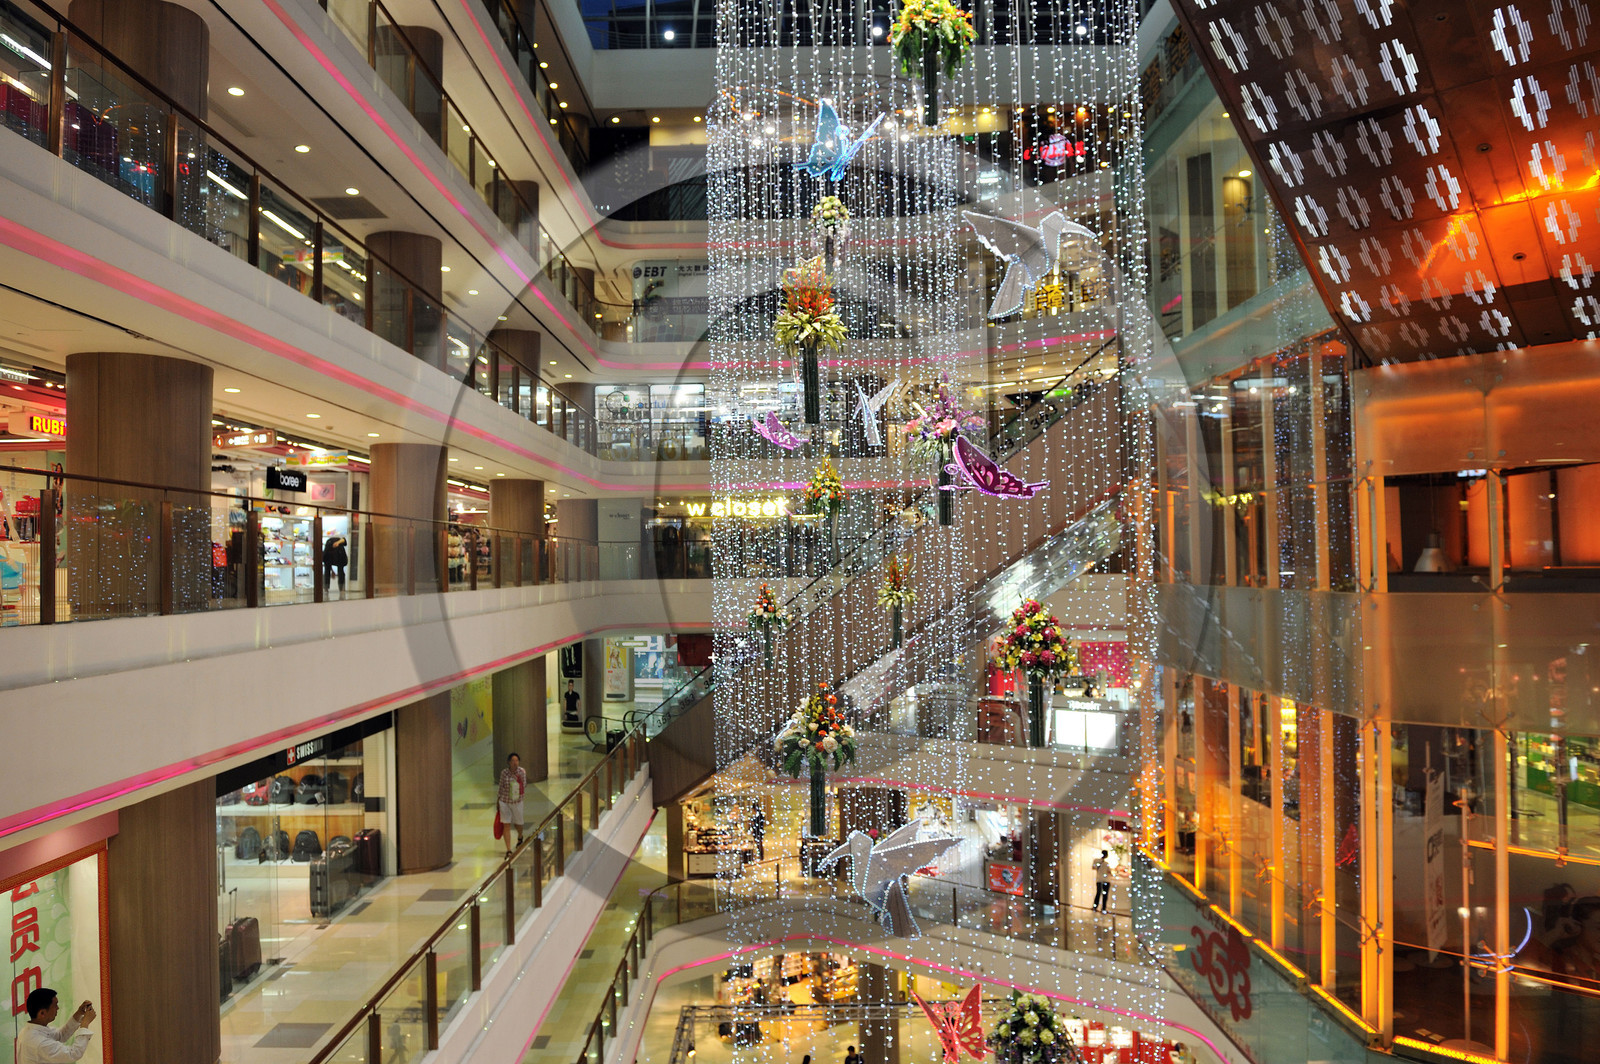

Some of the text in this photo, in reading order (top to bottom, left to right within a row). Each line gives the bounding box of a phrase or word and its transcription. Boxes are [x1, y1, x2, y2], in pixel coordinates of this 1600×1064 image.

[643, 266, 668, 277] EBT
[686, 496, 789, 517] w closet
[656, 711, 672, 728] 353
[1195, 900, 1227, 936] PLAZA
[1190, 925, 1252, 1022] 353
